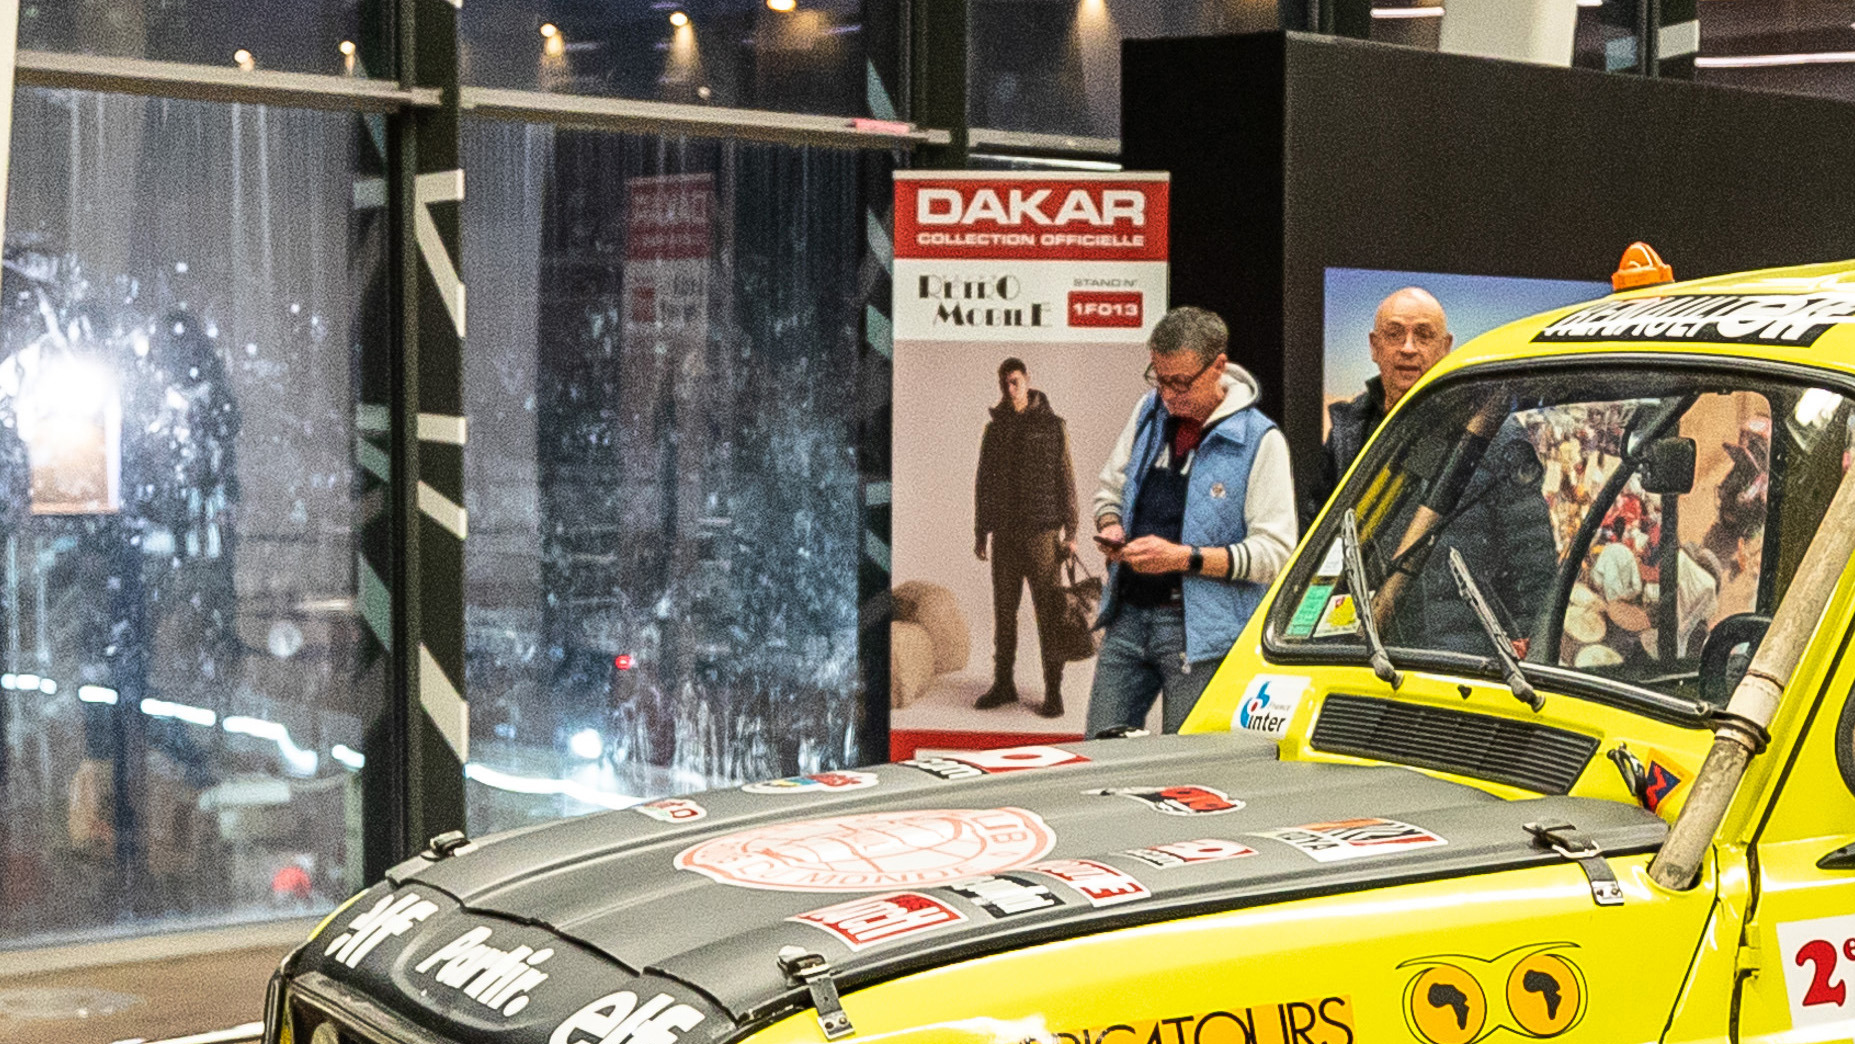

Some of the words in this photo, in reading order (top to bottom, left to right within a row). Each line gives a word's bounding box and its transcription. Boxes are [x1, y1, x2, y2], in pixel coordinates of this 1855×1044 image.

[916, 188, 1146, 227] DAKAR
[916, 232, 1036, 247] COLLECTION
[1040, 233, 1145, 248] OFFICIELLE
[1073, 278, 1121, 288] STAND
[1072, 302, 1139, 318] 1F013
[1247, 711, 1287, 733] inter
[324, 891, 439, 970] elf
